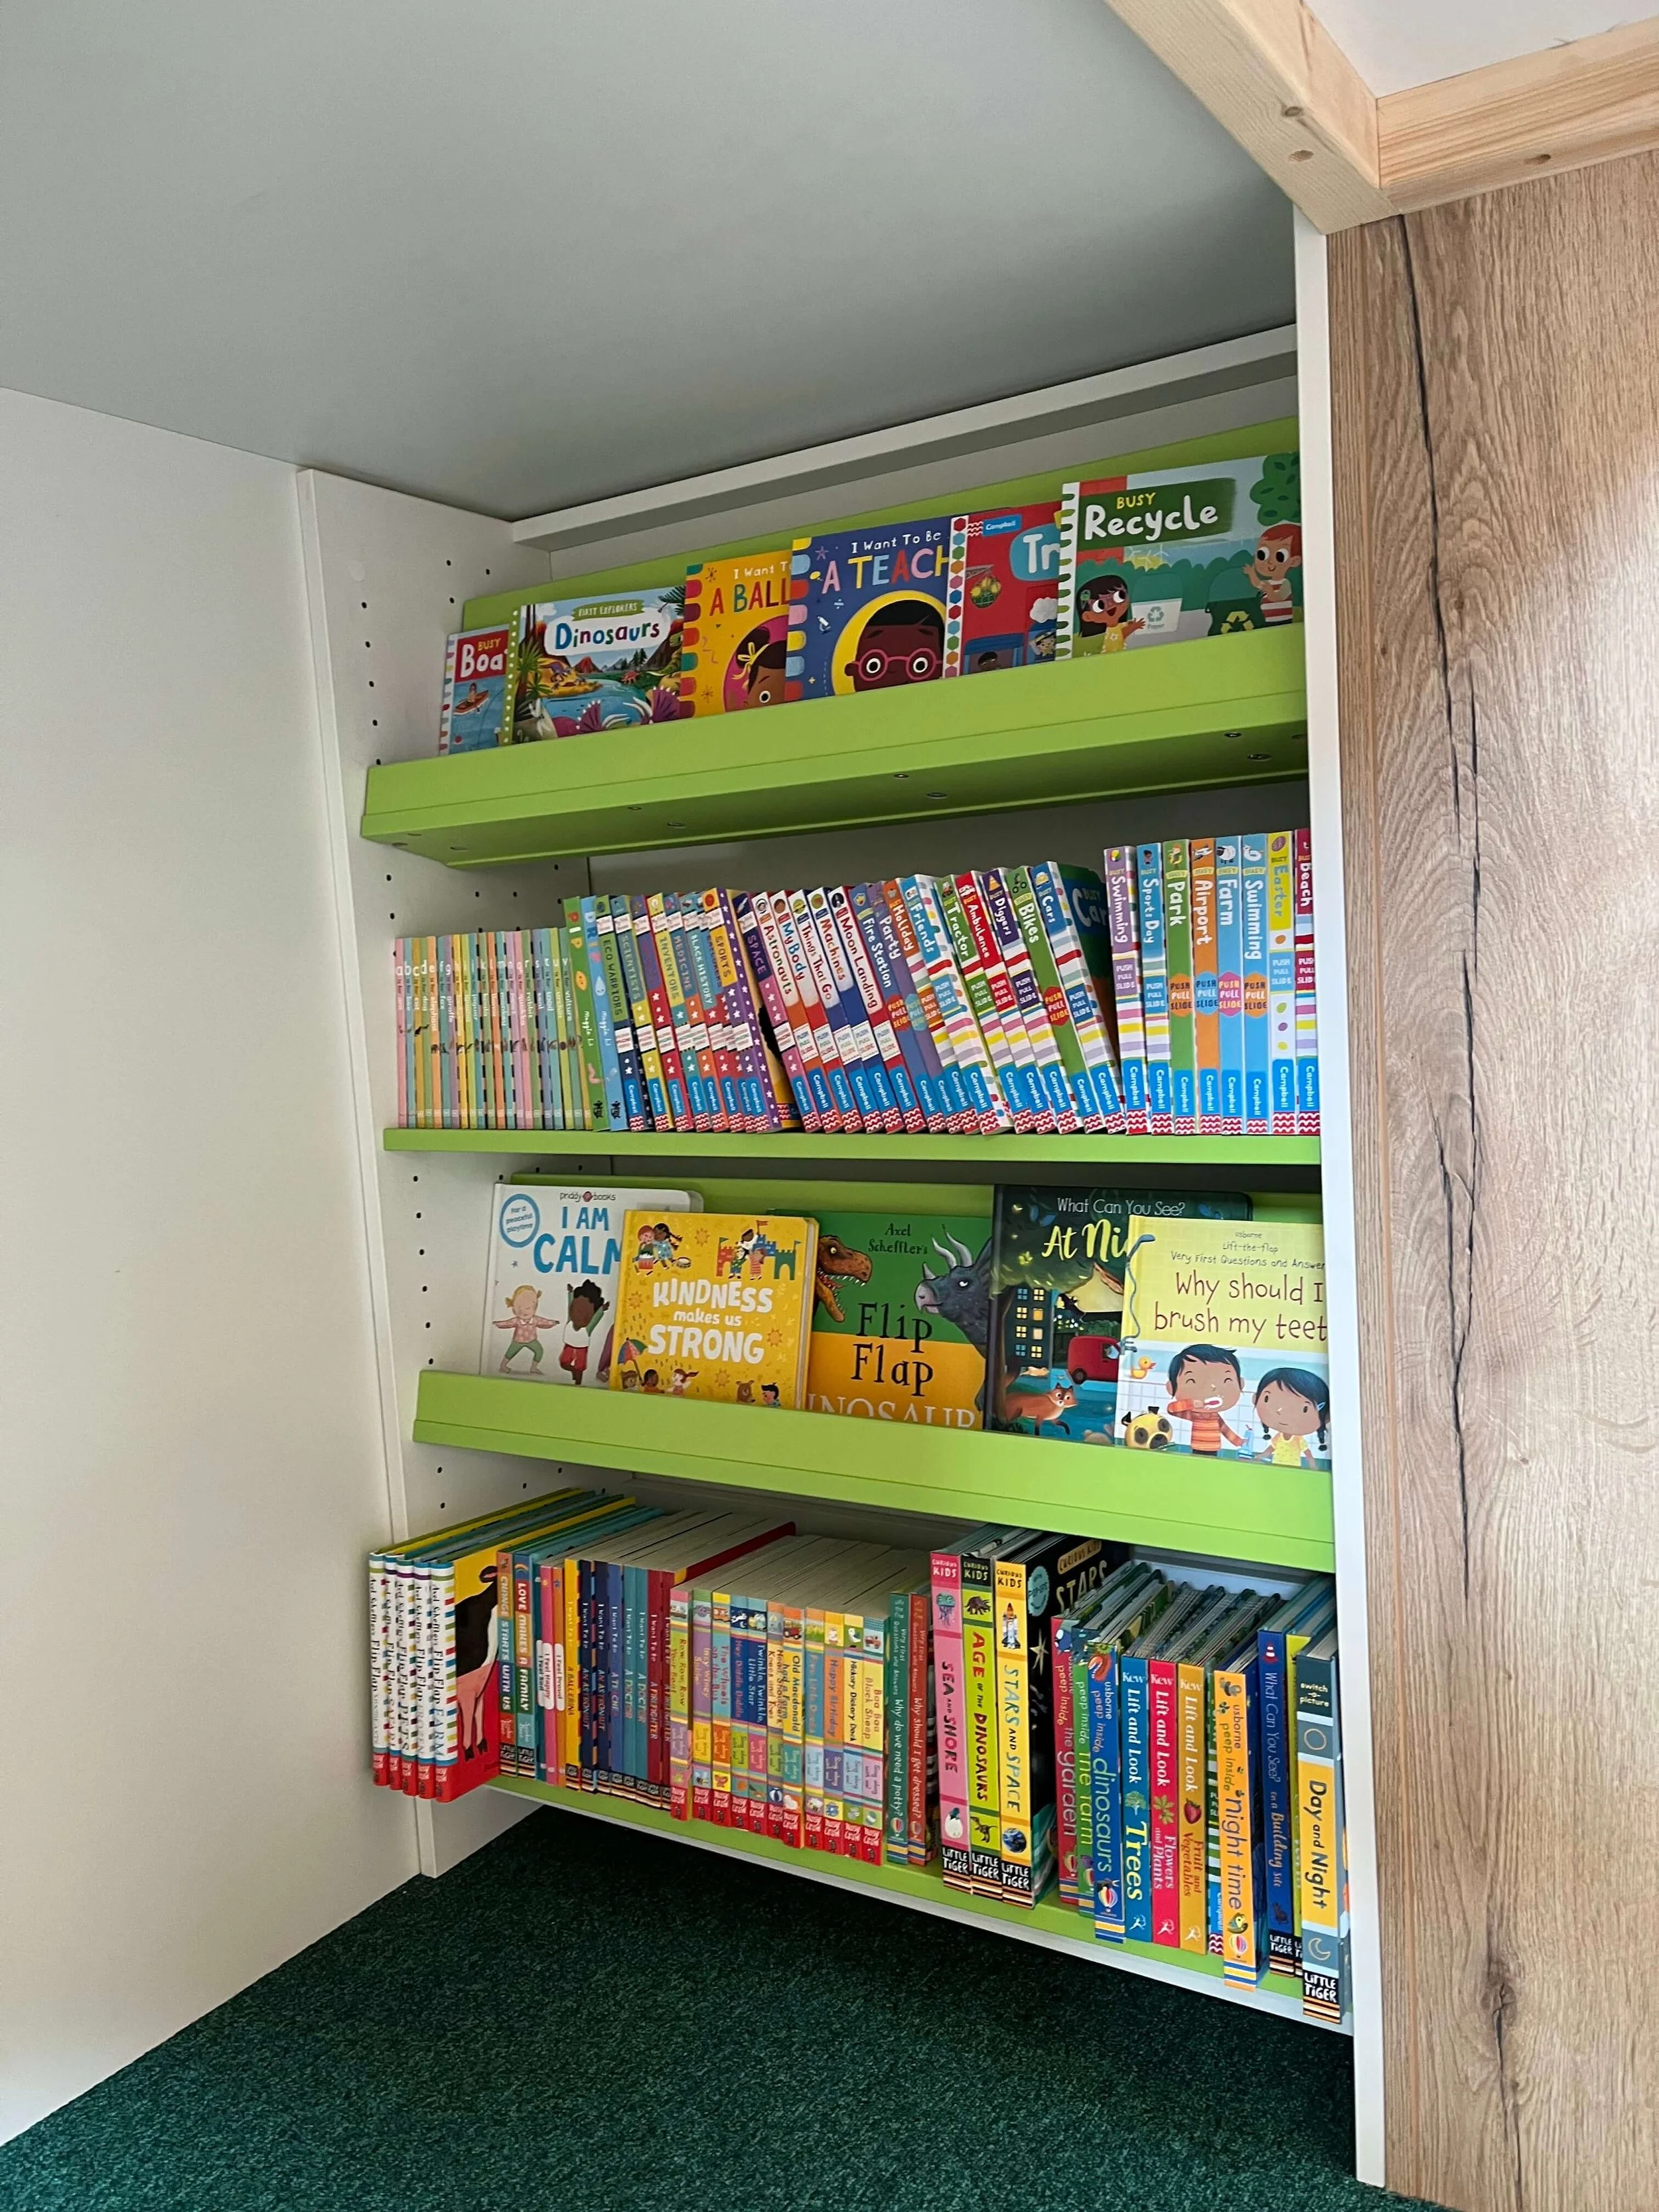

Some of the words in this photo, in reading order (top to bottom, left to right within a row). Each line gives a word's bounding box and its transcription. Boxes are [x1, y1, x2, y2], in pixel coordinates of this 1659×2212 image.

[1085, 494, 1218, 541] Recycle
[1116, 492, 1156, 510] BUSY
[851, 542, 857, 553] I
[863, 537, 897, 551] Want
[902, 534, 920, 545] To
[926, 531, 941, 542] Be
[985, 520, 1015, 531] Campbell
[733, 569, 739, 579] I
[745, 565, 774, 577] Want
[822, 561, 841, 594] A
[578, 606, 597, 617] FIRST
[599, 601, 637, 615] EXPLORERS
[709, 588, 724, 616] A
[478, 637, 501, 652] BUSY
[555, 621, 660, 650] Dinosaurs
[460, 644, 508, 679] Boa
[1143, 879, 1159, 917] Sports
[1167, 879, 1187, 926] Park
[1219, 879, 1238, 925] Farm
[1271, 864, 1288, 917] Easter
[892, 905, 914, 950] Holiday
[995, 898, 1011, 936] Diggers
[1019, 903, 1039, 944] Bikes
[1042, 896, 1055, 923] Cars
[1110, 876, 1128, 943] Swimming
[1193, 880, 1212, 945] Airport
[1244, 880, 1263, 959] Swimming
[784, 923, 794, 944] My
[880, 915, 901, 958] Party
[910, 905, 934, 953] Friends
[947, 901, 969, 956] Tractor
[968, 905, 990, 958] Ambulance
[1143, 919, 1159, 945] Day
[603, 939, 613, 962] ECO
[661, 936, 679, 999] INVENTORS
[715, 936, 730, 977] SPORTS
[748, 934, 766, 974] SPACE
[764, 925, 791, 995] Astronauts
[788, 940, 806, 980] Body
[802, 925, 817, 956] Things
[813, 955, 824, 982] That
[822, 984, 831, 1000] Go
[820, 919, 845, 980] Machines
[841, 916, 858, 954] Moon
[854, 955, 877, 1008] Landing
[863, 919, 874, 942] Fire
[870, 944, 892, 988] Station
[691, 934, 702, 961] BLACK
[697, 962, 713, 1005] HISTORY
[607, 964, 622, 1015] WARRIORS
[587, 1037, 594, 1047] Li
[812, 1074, 828, 1109] Campbell
[1129, 1067, 1139, 1106] Campbell
[562, 1207, 567, 1228] I
[576, 1207, 609, 1230] AM
[1057, 1197, 1089, 1213] What
[1094, 1199, 1121, 1214] Can
[1125, 1201, 1151, 1215] You
[1154, 1202, 1185, 1217] See?
[868, 1239, 928, 1255] Scheffler's
[885, 1222, 911, 1237] Axel
[1043, 1224, 1077, 1260] At
[1171, 1251, 1191, 1264] Very
[1195, 1254, 1216, 1264] First
[1221, 1255, 1267, 1267] Questions
[1271, 1258, 1287, 1268] and
[653, 1278, 774, 1313] KINDNESS
[1176, 1270, 1220, 1308] Why
[1228, 1272, 1303, 1305] should
[1313, 1283, 1323, 1303] I
[673, 1309, 719, 1325] makes
[725, 1313, 741, 1325] us
[856, 1302, 932, 1353] Flip
[1154, 1301, 1219, 1333] brush
[1229, 1319, 1266, 1343] my
[648, 1325, 764, 1364] STRONG
[850, 1343, 933, 1397] Flap
[997, 1568, 1022, 1578] CURIOUS
[997, 1576, 1021, 1588] KIDS
[1056, 1560, 1107, 1610] STARS
[518, 1583, 527, 1610] LOVE
[519, 1615, 530, 1653] MAKES
[972, 1632, 984, 1677] AGE
[519, 1669, 530, 1712] FAMILY
[848, 1660, 857, 1689] Hickory
[942, 1661, 956, 1696] SEA
[1265, 1672, 1277, 1700] What
[1301, 1682, 1328, 1692] switch
[848, 1692, 857, 1720] Dickory
[891, 1700, 904, 1718] Why
[1005, 1665, 1019, 1726] STARS
[1091, 1690, 1104, 1719] peep
[1105, 1682, 1114, 1720] usborne
[1128, 1688, 1141, 1714] Lift
[1299, 1696, 1329, 1707] picture
[895, 1721, 904, 1732] do
[1129, 1717, 1141, 1744] and
[1233, 1704, 1244, 1749] usborne
[1266, 1704, 1278, 1729] Can
[895, 1734, 902, 1748] we
[944, 1715, 958, 1772] SHORE
[1093, 1723, 1106, 1753] inside
[1220, 1723, 1232, 1753] peep
[1267, 1732, 1280, 1753] You
[894, 1751, 904, 1773] need
[974, 1712, 991, 1802] DINOSAURS
[1129, 1749, 1141, 1783] Look
[1224, 1757, 1235, 1791] inside
[1267, 1755, 1281, 1783] See?
[890, 1785, 903, 1816] potty?
[1005, 1752, 1020, 1812] SPACE
[1303, 1781, 1327, 1820] Day
[1093, 1758, 1117, 1872] dinosaurs
[1222, 1798, 1248, 1857] night
[1268, 1813, 1287, 1868] Building
[1313, 1824, 1325, 1848] and
[1126, 1822, 1147, 1901] Trees
[1153, 1846, 1165, 1889] Plants
[1165, 1836, 1176, 1888] Flowers
[1181, 1832, 1194, 1897] Vegetables
[1194, 1840, 1203, 1871] Fruit
[1228, 1864, 1246, 1910] time
[1305, 1852, 1330, 1909] Night
[1303, 1972, 1336, 1988] LITTLE
[1303, 1986, 1337, 2003] TIGER
